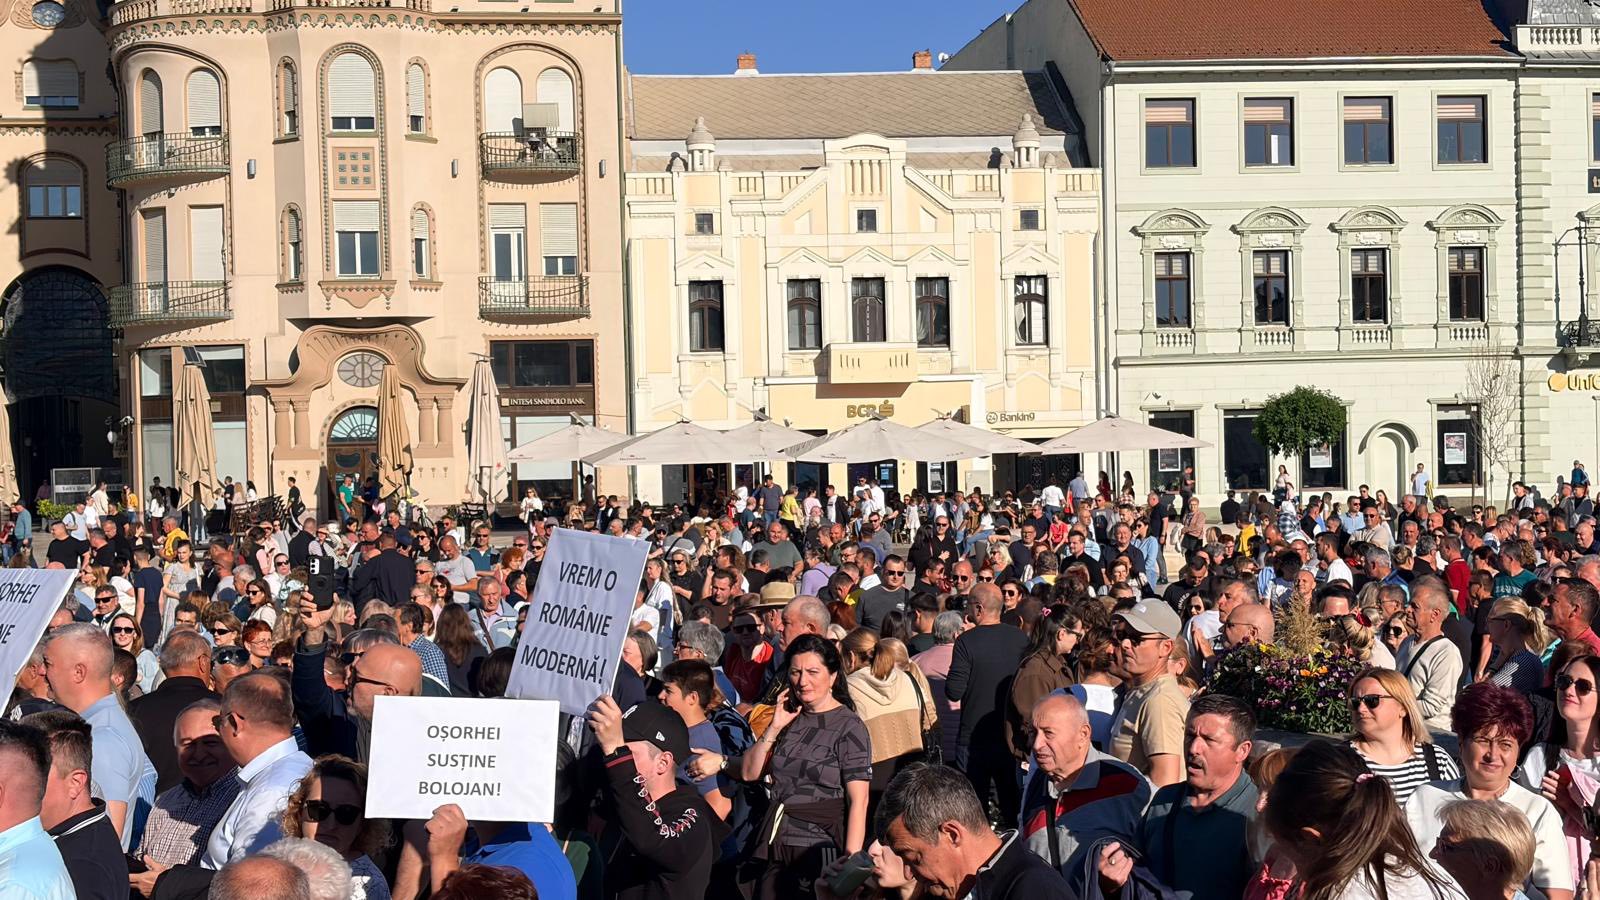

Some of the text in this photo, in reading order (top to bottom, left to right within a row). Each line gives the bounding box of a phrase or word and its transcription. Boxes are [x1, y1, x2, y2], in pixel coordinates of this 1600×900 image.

[510, 397, 585, 406] INTESA SANPAOLO BANK
[846, 404, 877, 419] BCR
[1000, 412, 1035, 423] Banking
[559, 561, 618, 592] VREM O
[538, 602, 613, 637] ROMÂNIE
[520, 644, 608, 685] MODERNĂ!
[427, 725, 501, 743] OȘORHEI
[427, 753, 497, 772] SUSȚINE
[418, 781, 501, 797] BOLOJAN!
